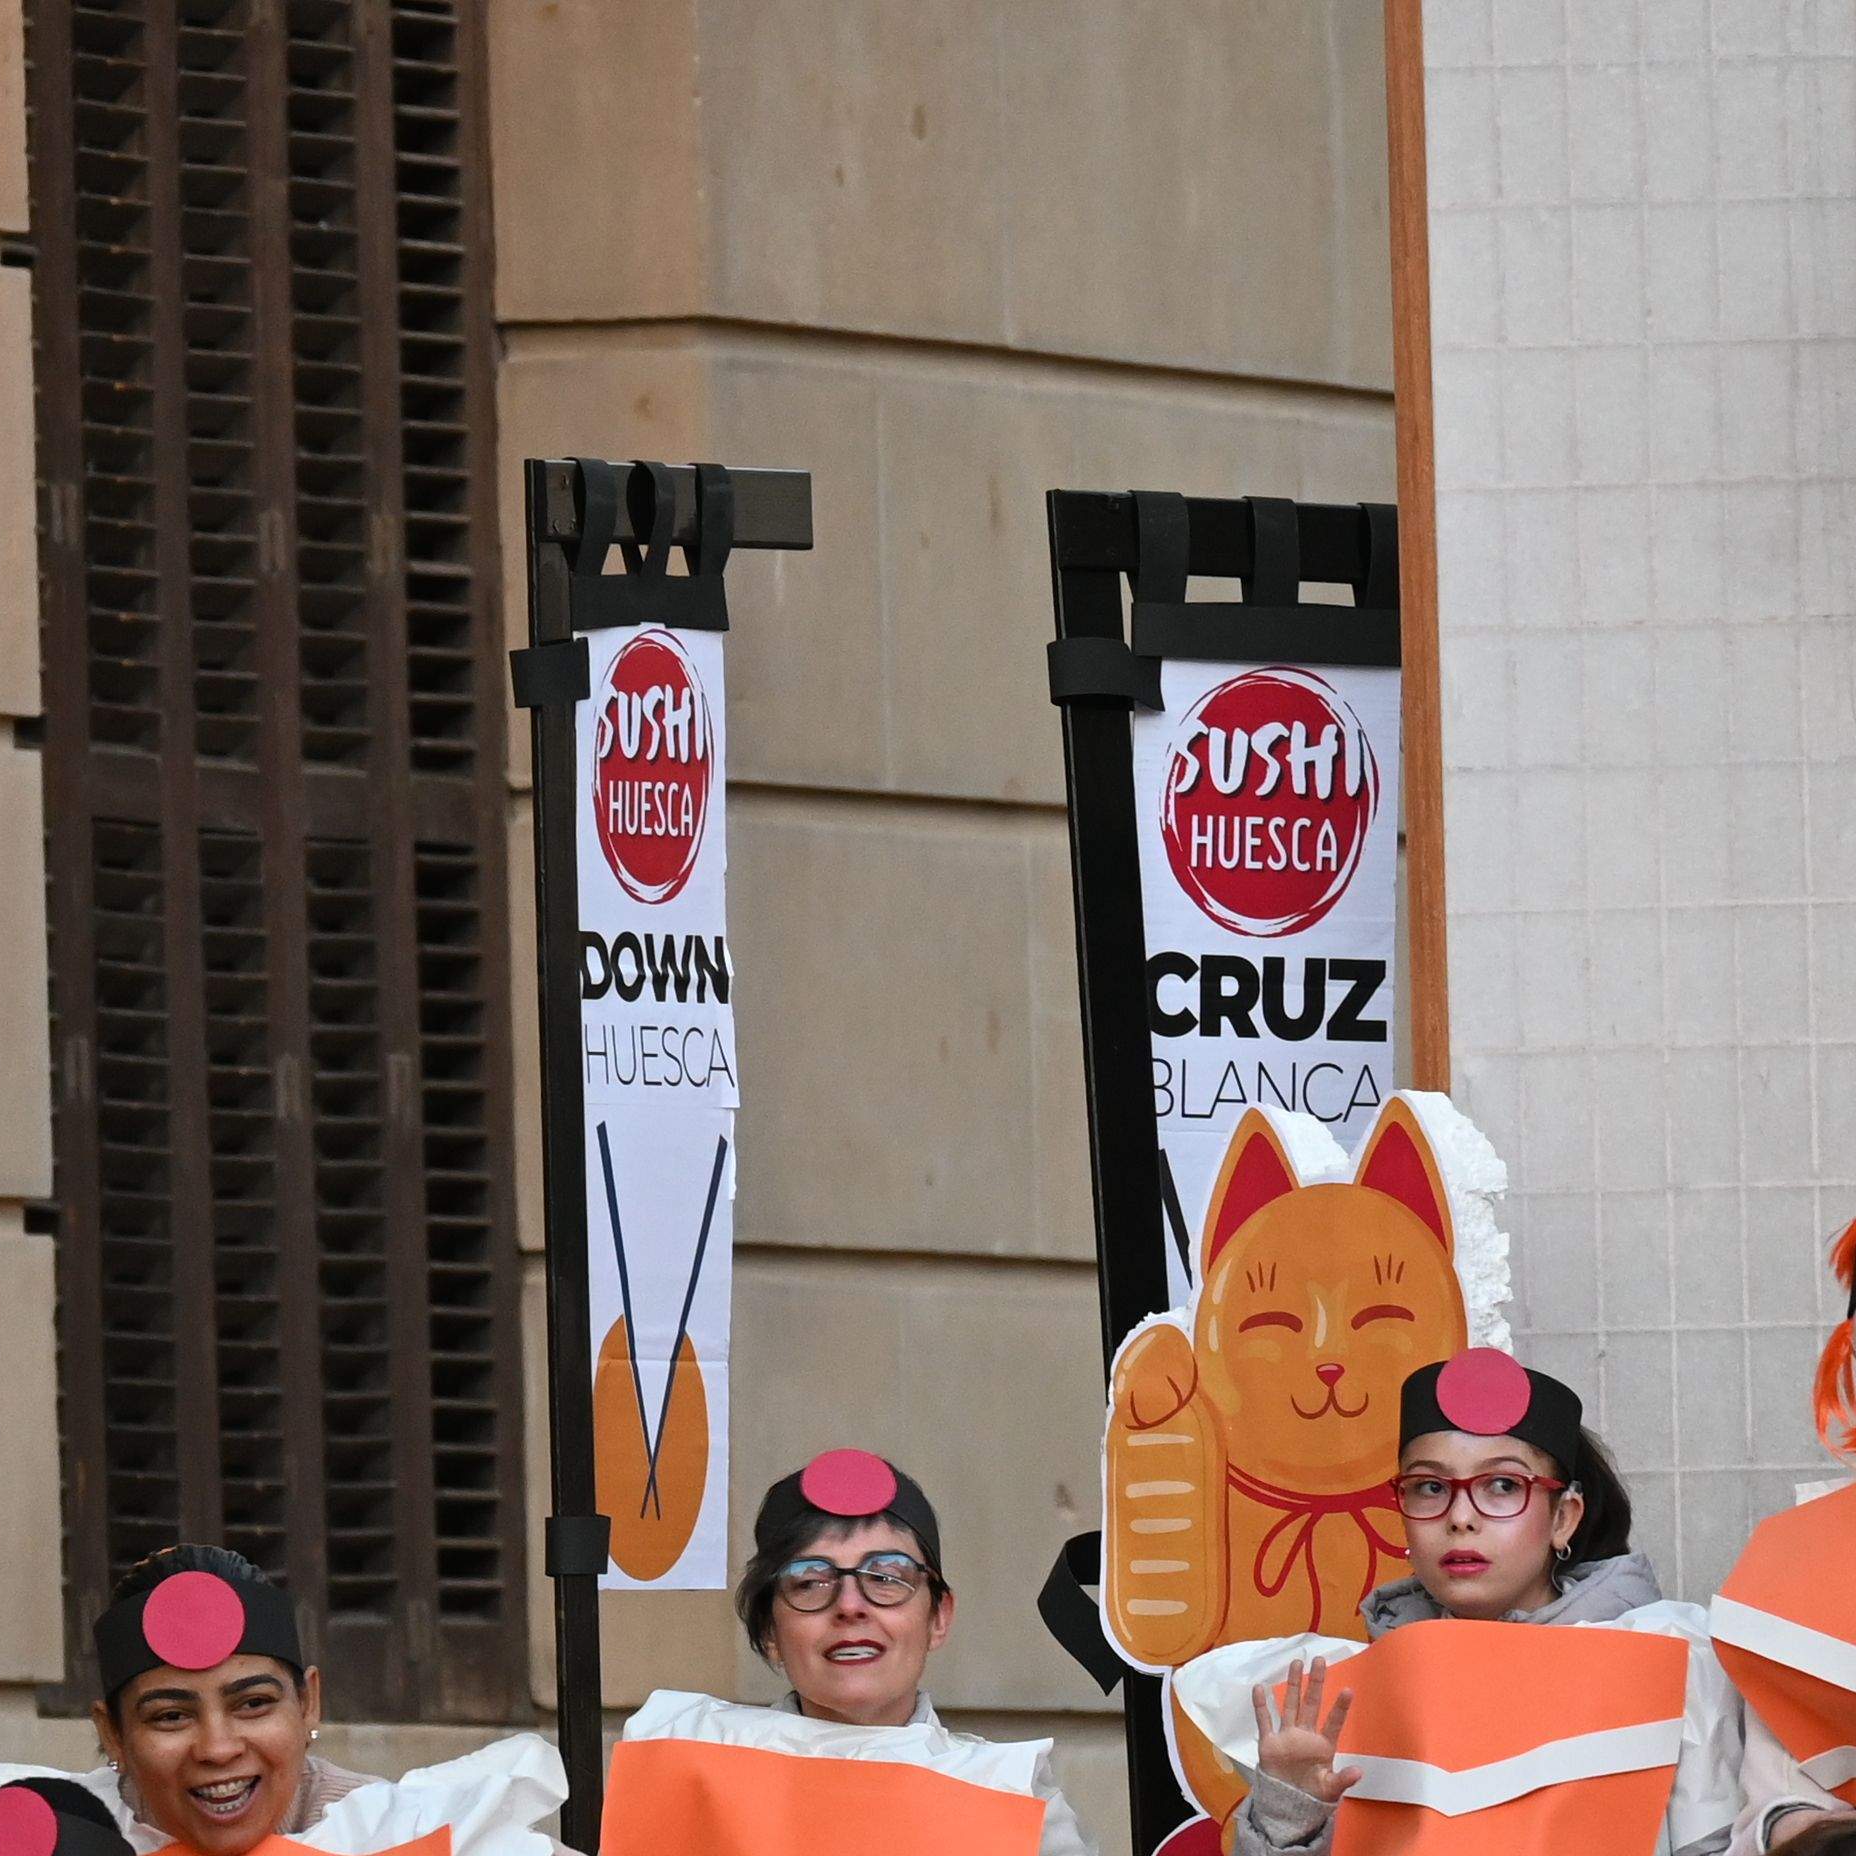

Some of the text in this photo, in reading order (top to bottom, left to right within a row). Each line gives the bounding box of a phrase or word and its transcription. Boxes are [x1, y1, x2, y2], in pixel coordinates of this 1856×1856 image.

[597, 683, 707, 763] SUSHI
[1169, 719, 1363, 800] SUSHI
[608, 780, 693, 837] HUESCA
[1190, 814, 1338, 872] HUESCA
[579, 931, 729, 1004] DOWN
[1145, 951, 1387, 1042] CRUZ
[584, 1024, 735, 1088] HUESCA
[1152, 1058, 1381, 1122] BLANCA
